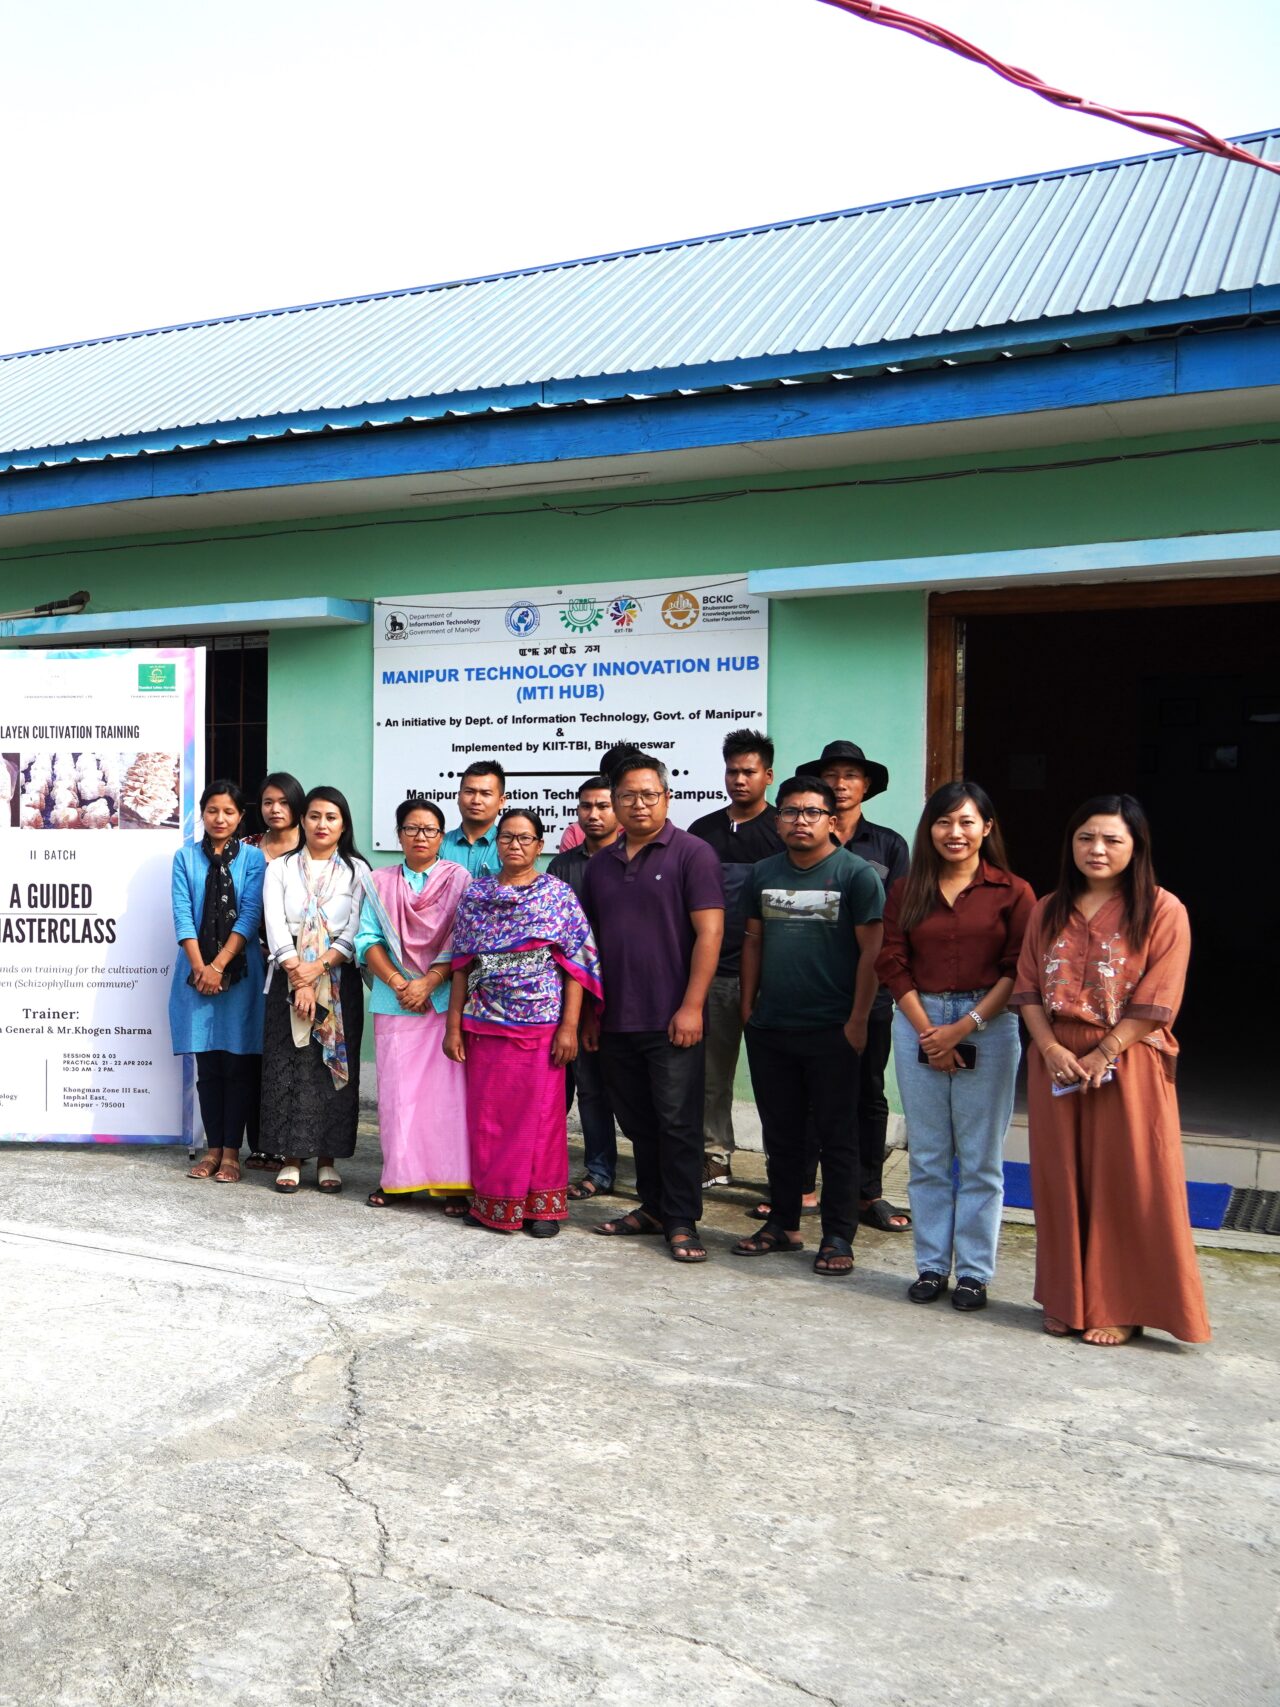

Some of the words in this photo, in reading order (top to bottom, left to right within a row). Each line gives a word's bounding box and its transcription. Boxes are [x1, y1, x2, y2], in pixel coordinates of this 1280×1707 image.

[702, 594, 734, 604] BCKIC
[409, 612, 444, 620] Department
[409, 628, 445, 636] Government
[382, 669, 459, 684] MANIPUR
[464, 663, 586, 681] TECHNOLOGY
[593, 658, 710, 676] INNOVATION
[717, 656, 760, 672] HUB
[517, 686, 553, 703] (MTI
[559, 684, 604, 701] HUB)
[385, 718, 399, 727] An
[402, 717, 446, 726] initiative
[449, 717, 462, 727] by
[465, 716, 493, 727] Dept.
[497, 715, 508, 724] of
[512, 714, 576, 724] Information
[580, 712, 650, 723] Technology,
[653, 711, 684, 721] Govt.
[689, 710, 701, 719] of
[705, 709, 756, 720] Manipur
[32, 725, 92, 739] CULTIVATION
[95, 725, 140, 739] TRAINING
[555, 728, 564, 737] &
[452, 742, 522, 754] Implemented
[526, 742, 539, 753] by
[542, 741, 591, 751] KIIT-TBI,
[406, 789, 457, 802] Manipur
[30, 850, 36, 860] II
[44, 850, 76, 860] BATCH
[9, 883, 22, 908] A
[28, 883, 92, 909] GUIDED
[35, 965, 73, 976] training
[74, 965, 89, 975] for
[91, 965, 106, 974] the
[108, 965, 158, 974] cultivation
[160, 965, 170, 976] of
[15, 979, 84, 990] (Schizophyllum
[86, 979, 138, 990] commune)"
[22, 1008, 79, 1020] Trainer:
[5, 1026, 44, 1034] General
[47, 1026, 54, 1034] &
[57, 1026, 111, 1036] Mr.Khogen
[114, 1026, 152, 1035] Sharma
